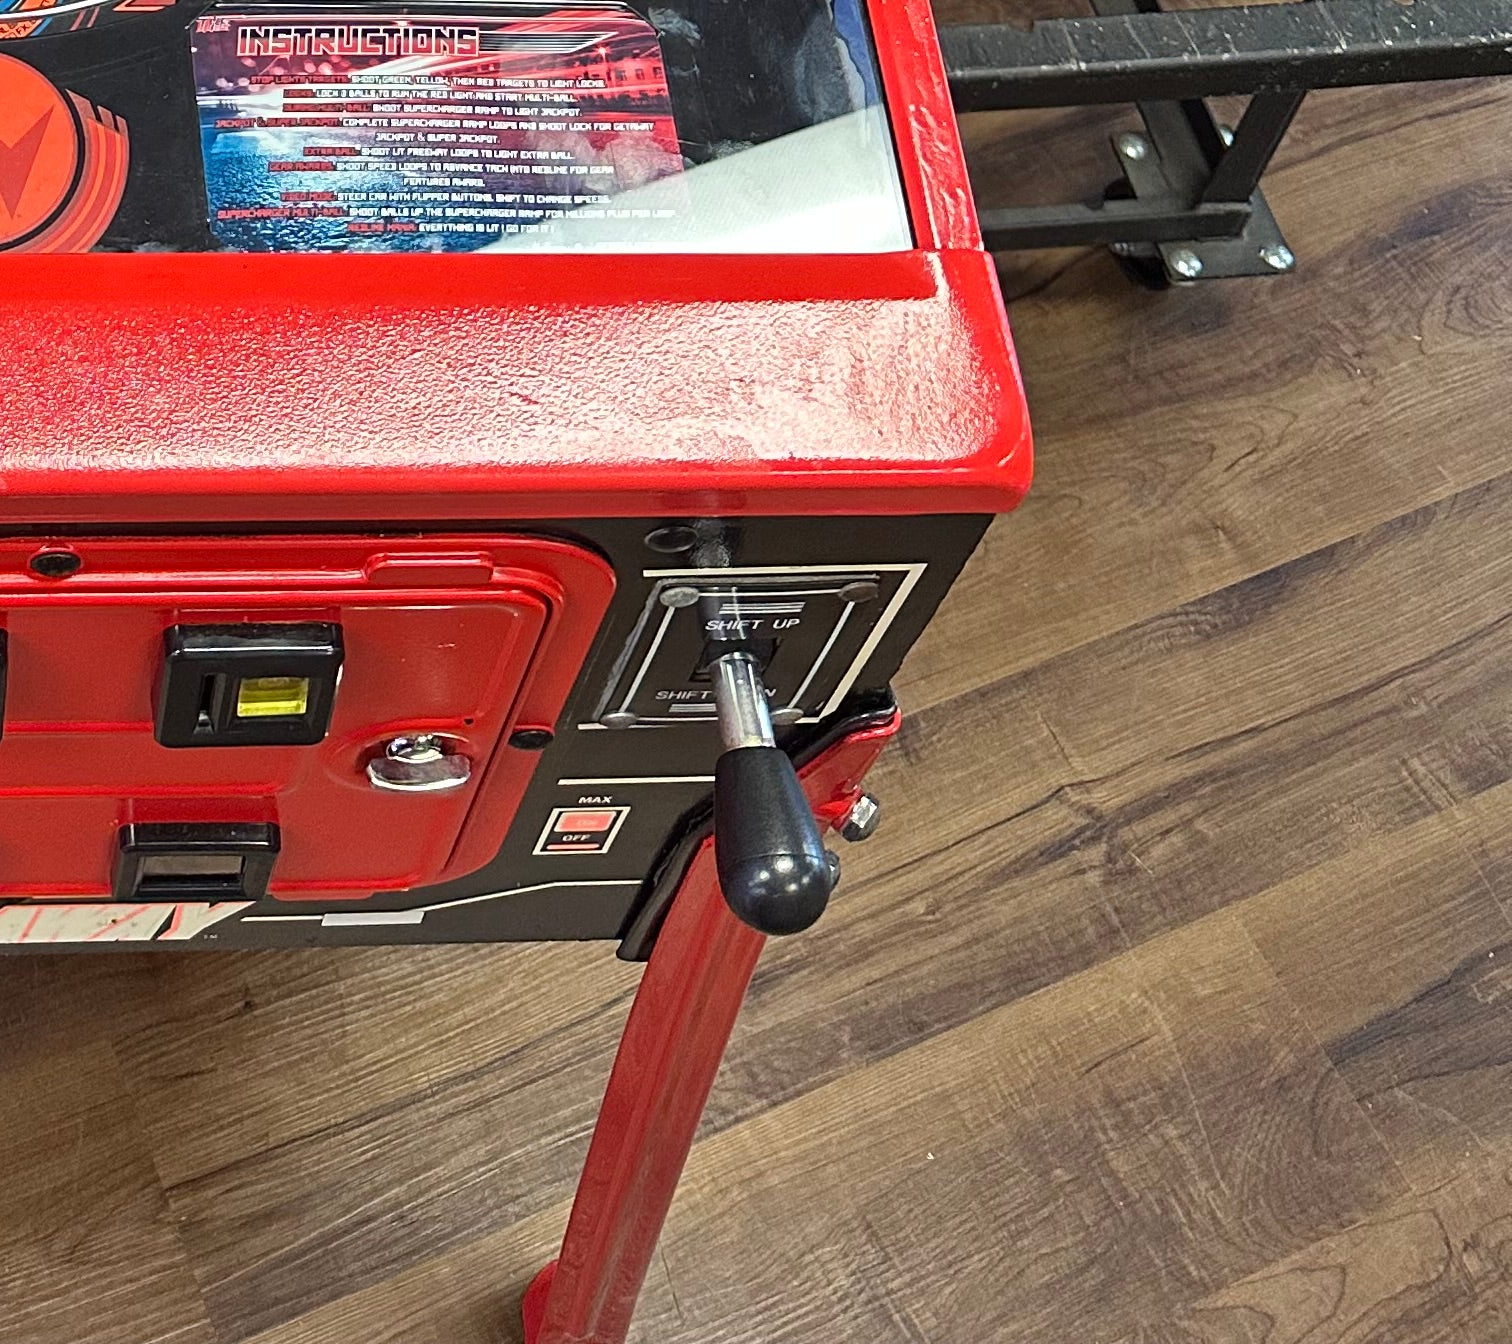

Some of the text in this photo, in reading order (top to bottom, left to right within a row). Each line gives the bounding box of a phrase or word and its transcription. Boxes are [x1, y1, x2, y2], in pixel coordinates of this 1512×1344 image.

[237, 25, 481, 58] INSTRUCTIONS
[705, 618, 801, 631] SHIFT UP
[655, 690, 714, 700] SHIFT
[578, 795, 614, 805] MAX
[562, 833, 591, 842] OFF
